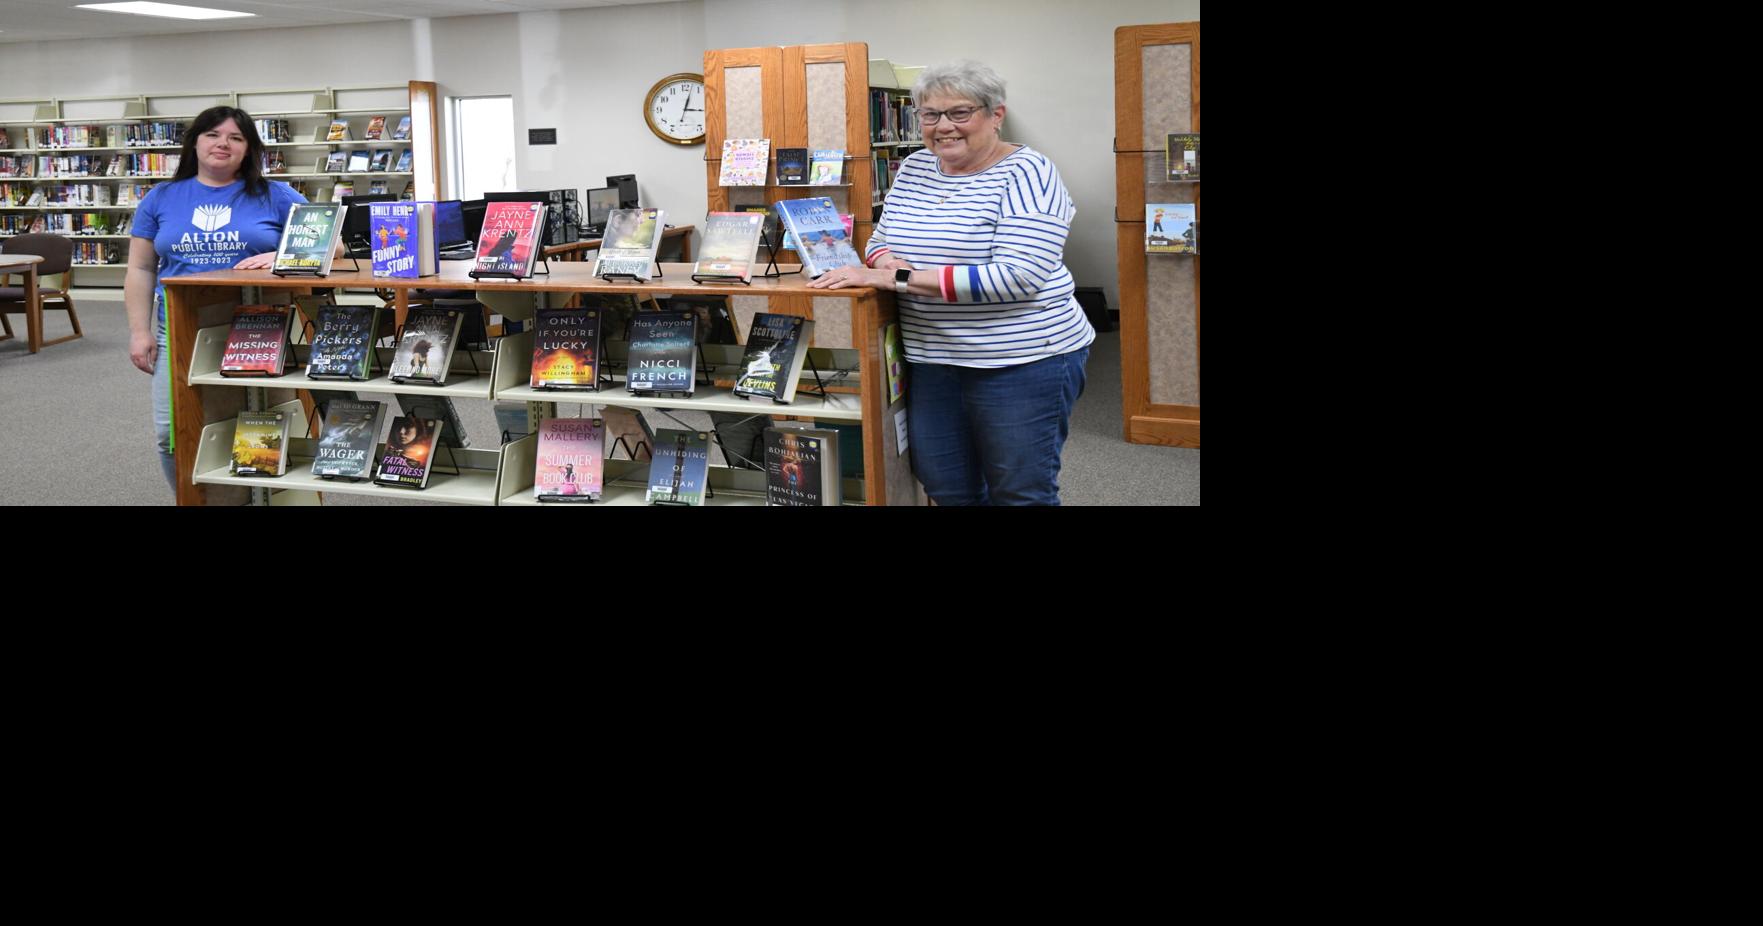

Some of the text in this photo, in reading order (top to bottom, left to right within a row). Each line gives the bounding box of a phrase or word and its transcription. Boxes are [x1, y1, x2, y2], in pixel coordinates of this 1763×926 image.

[681, 84, 690, 92] 12
[656, 106, 663, 114] 9
[371, 205, 390, 216] EMILY
[491, 210, 532, 220] JAYNE
[303, 212, 319, 222] AN
[800, 215, 833, 225] CARR
[494, 220, 524, 229] ANN
[288, 224, 329, 235] HONEST
[482, 229, 534, 238] KRENTZ
[180, 231, 240, 244] ALTON
[171, 241, 248, 253] PUBLIC LIBRARY
[292, 237, 317, 248] MAN
[372, 244, 401, 264] FUNNY
[191, 257, 231, 265] 1923-2023
[387, 255, 415, 274] STORY
[549, 317, 586, 325] ONLY
[633, 320, 692, 328] Has Anyone
[768, 318, 784, 327] LISA
[324, 321, 359, 334] Berry
[553, 329, 594, 337] YOU'RE
[649, 330, 674, 338] Seen
[752, 327, 796, 340] SCOTTOLINE
[315, 334, 362, 345] Pickers
[228, 341, 278, 350] MISSING
[543, 341, 588, 350] LUCKY
[225, 353, 277, 361] WITNESS
[317, 352, 353, 360] Amanda
[317, 364, 347, 372] Peters
[640, 360, 680, 369] NICCI
[632, 372, 687, 381] FRENCH
[551, 424, 593, 433] SUSAN
[544, 432, 599, 441] MALLERY
[778, 439, 805, 448] CHRIS
[320, 448, 365, 460] WAGER
[655, 448, 706, 459] UNHIDING
[768, 447, 817, 461] BOHJALIAN
[383, 455, 408, 466] FATAL
[545, 454, 592, 466] SUMMER
[386, 465, 424, 477] WITNESS
[672, 464, 686, 472] OF
[400, 476, 422, 484] BRADLEY
[543, 473, 593, 484] BOOK CLUB
[659, 478, 694, 488] ELIJAH
[768, 485, 804, 497] PRINCESS
